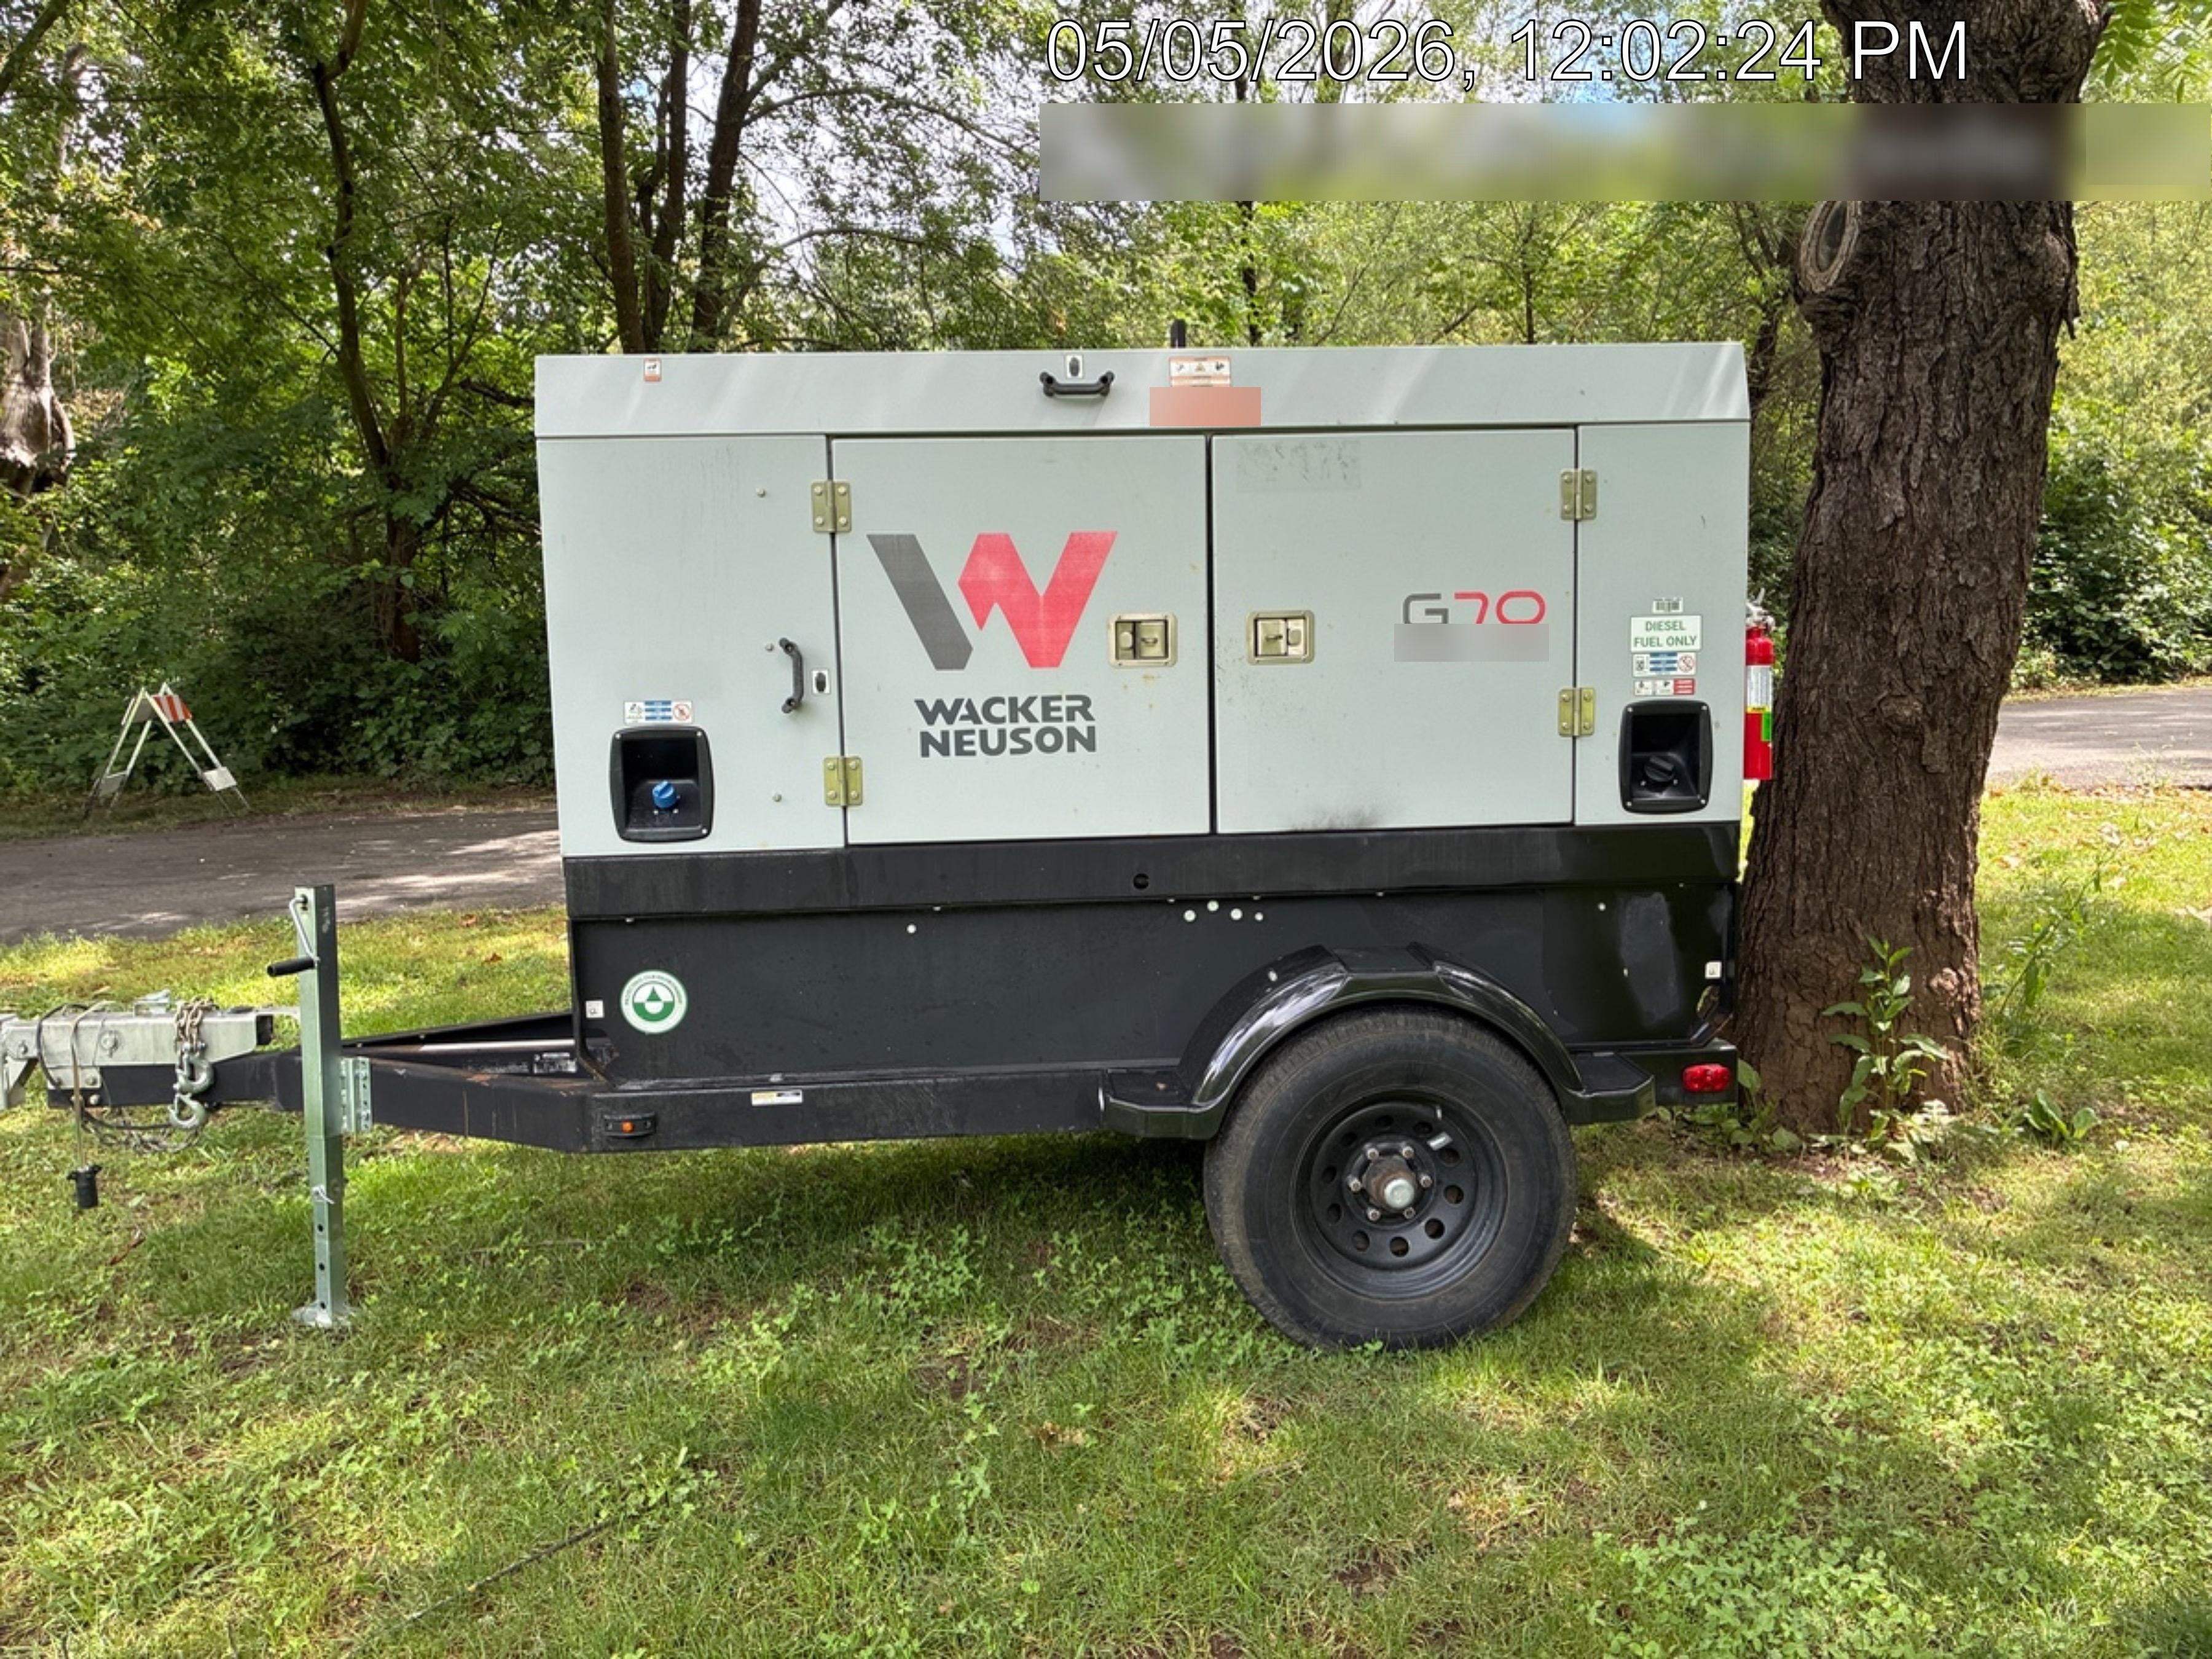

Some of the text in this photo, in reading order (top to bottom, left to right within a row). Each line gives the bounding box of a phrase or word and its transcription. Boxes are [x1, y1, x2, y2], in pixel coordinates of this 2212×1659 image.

[1403, 590, 1546, 624] G70
[1634, 635, 1697, 648] FUEL ONLY
[1645, 620, 1685, 632] DIESEL
[914, 694, 1096, 726] WACKER
[919, 726, 1096, 758] NEUSON
